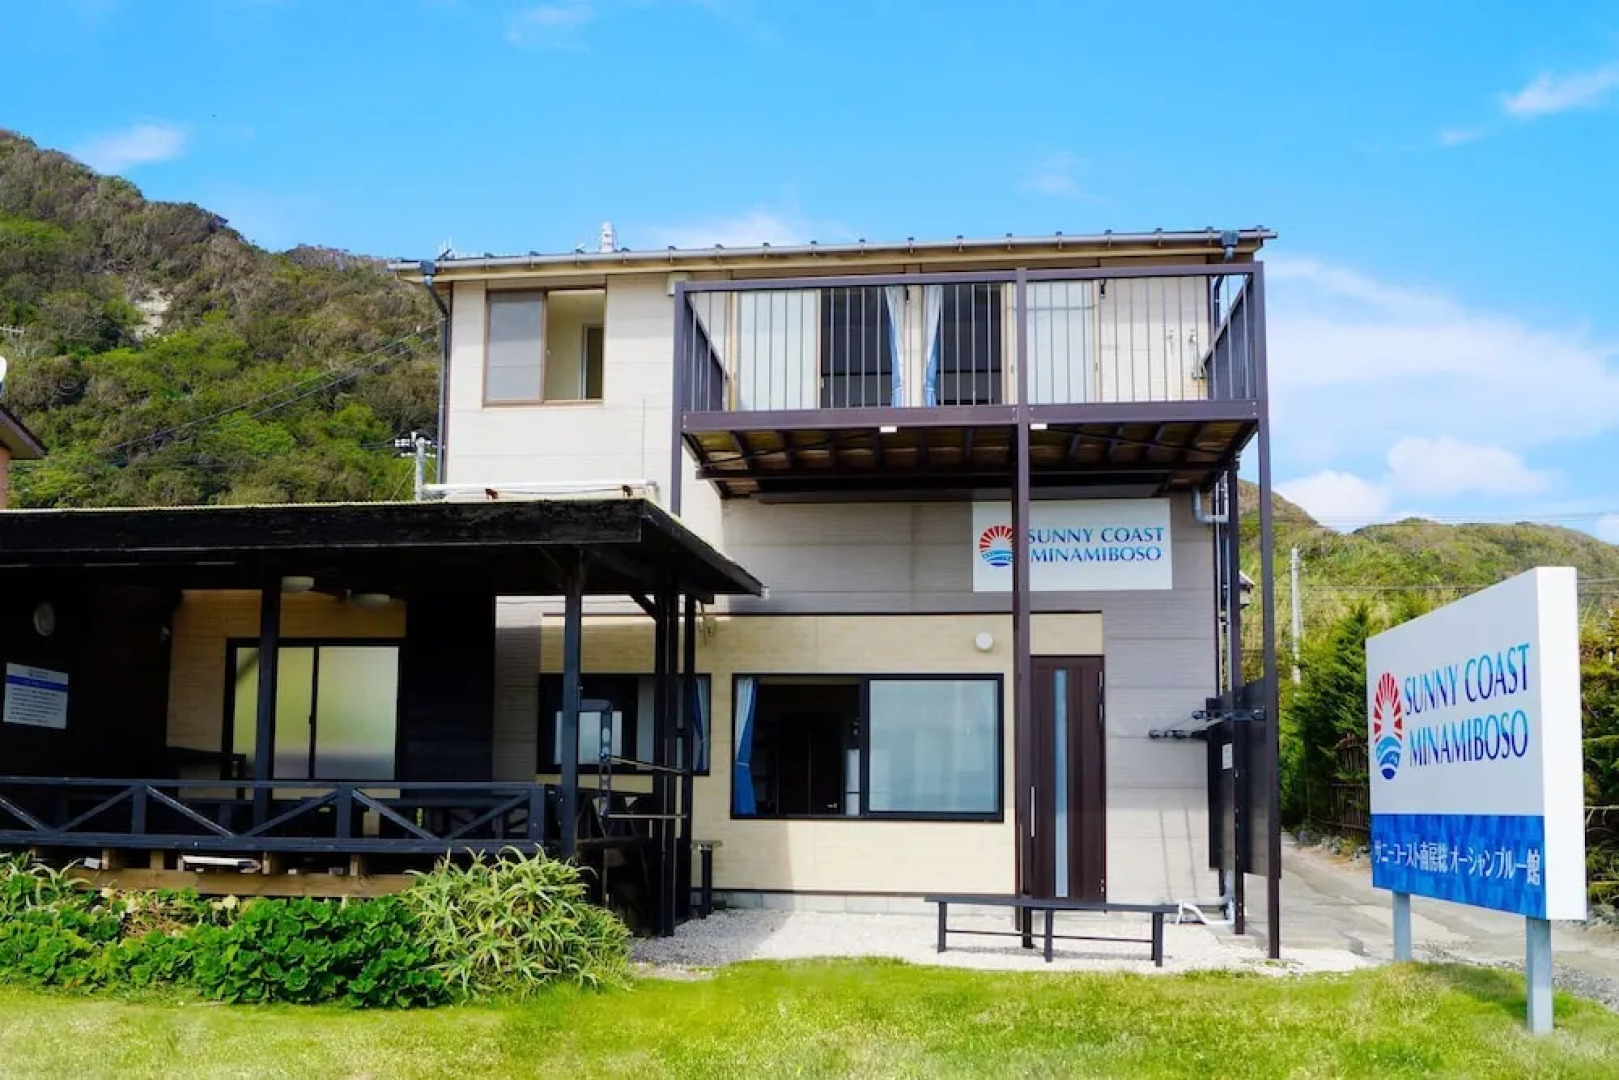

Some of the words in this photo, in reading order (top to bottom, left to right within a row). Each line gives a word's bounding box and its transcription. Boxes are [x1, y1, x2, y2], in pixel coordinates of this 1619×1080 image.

[1028, 528, 1093, 544] SUNNY
[1101, 527, 1164, 542] COAST
[1031, 546, 1162, 563] MINAMIBOSO
[1405, 664, 1458, 715] SUNNY
[1465, 642, 1530, 702] COAST
[1409, 710, 1528, 767] MINAMIBOSO
